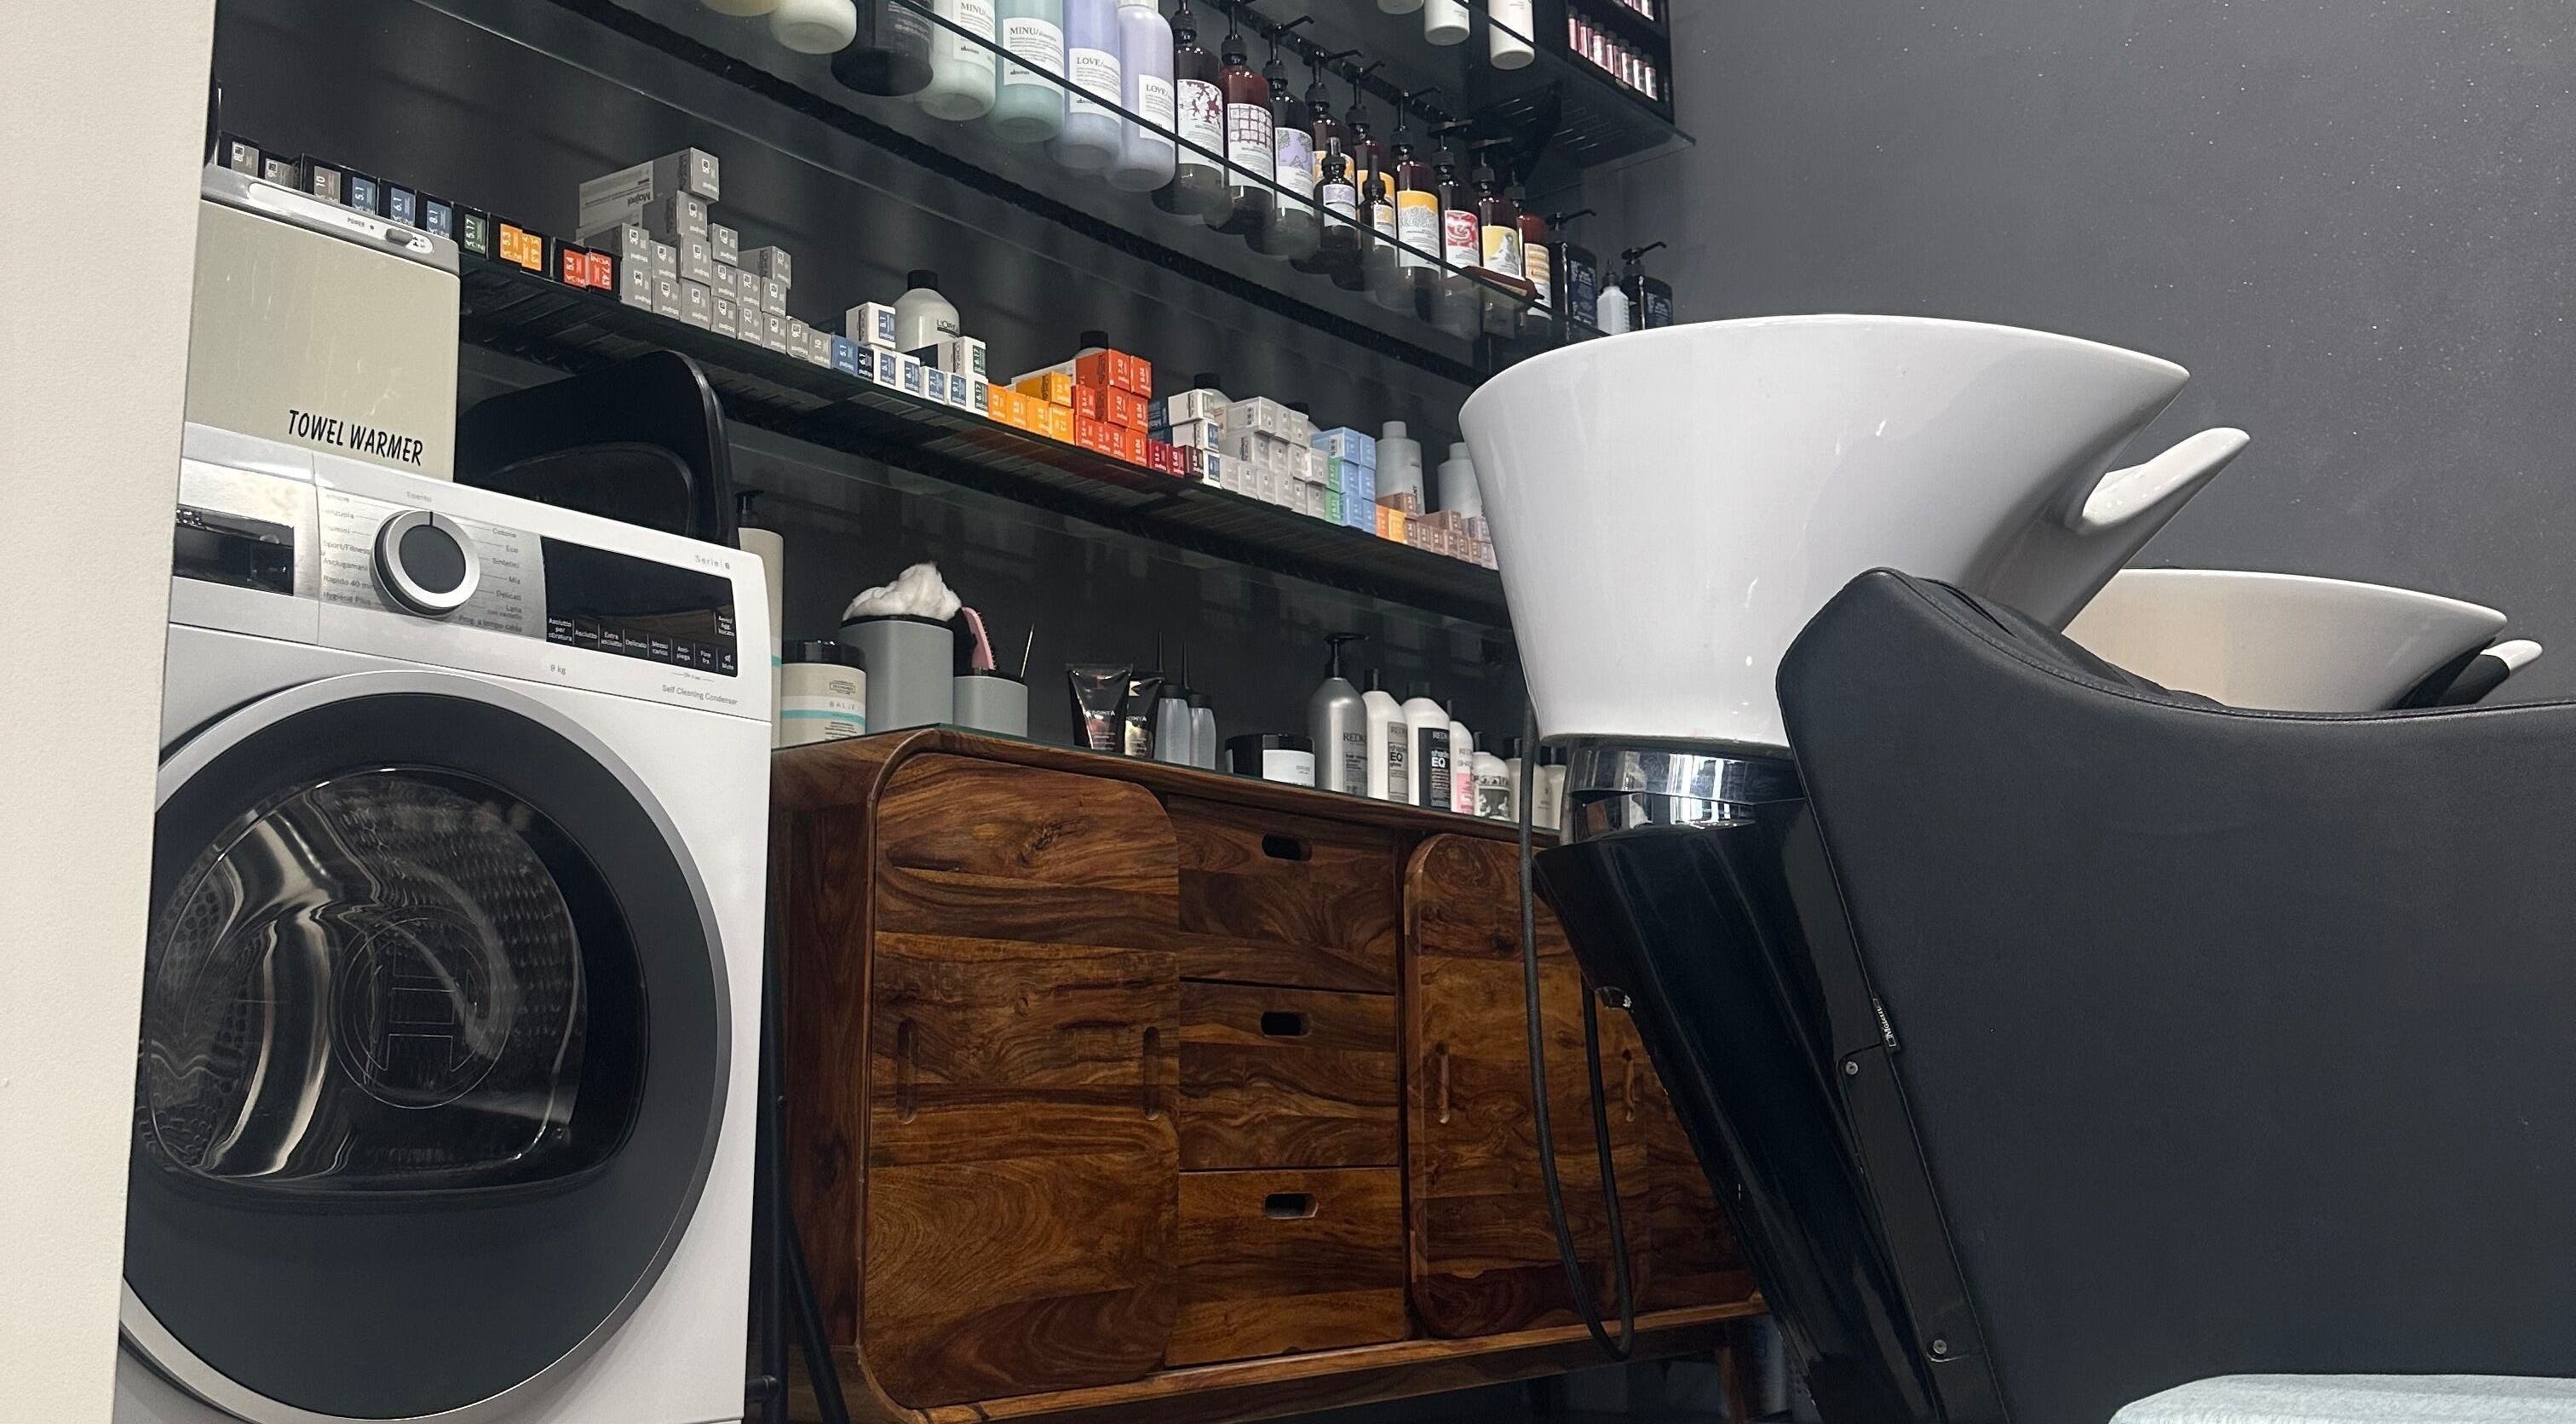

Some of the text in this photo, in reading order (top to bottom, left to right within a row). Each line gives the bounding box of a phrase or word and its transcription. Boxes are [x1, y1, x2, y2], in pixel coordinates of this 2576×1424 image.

[288, 410, 423, 467] TOWEL WARMER
[694, 554, 719, 567] Serie
[557, 665, 566, 675] kg
[662, 684, 738, 705] Self Cleaning Condenser
[1389, 751, 1404, 763] EQ
[1431, 757, 1446, 768] EQ
